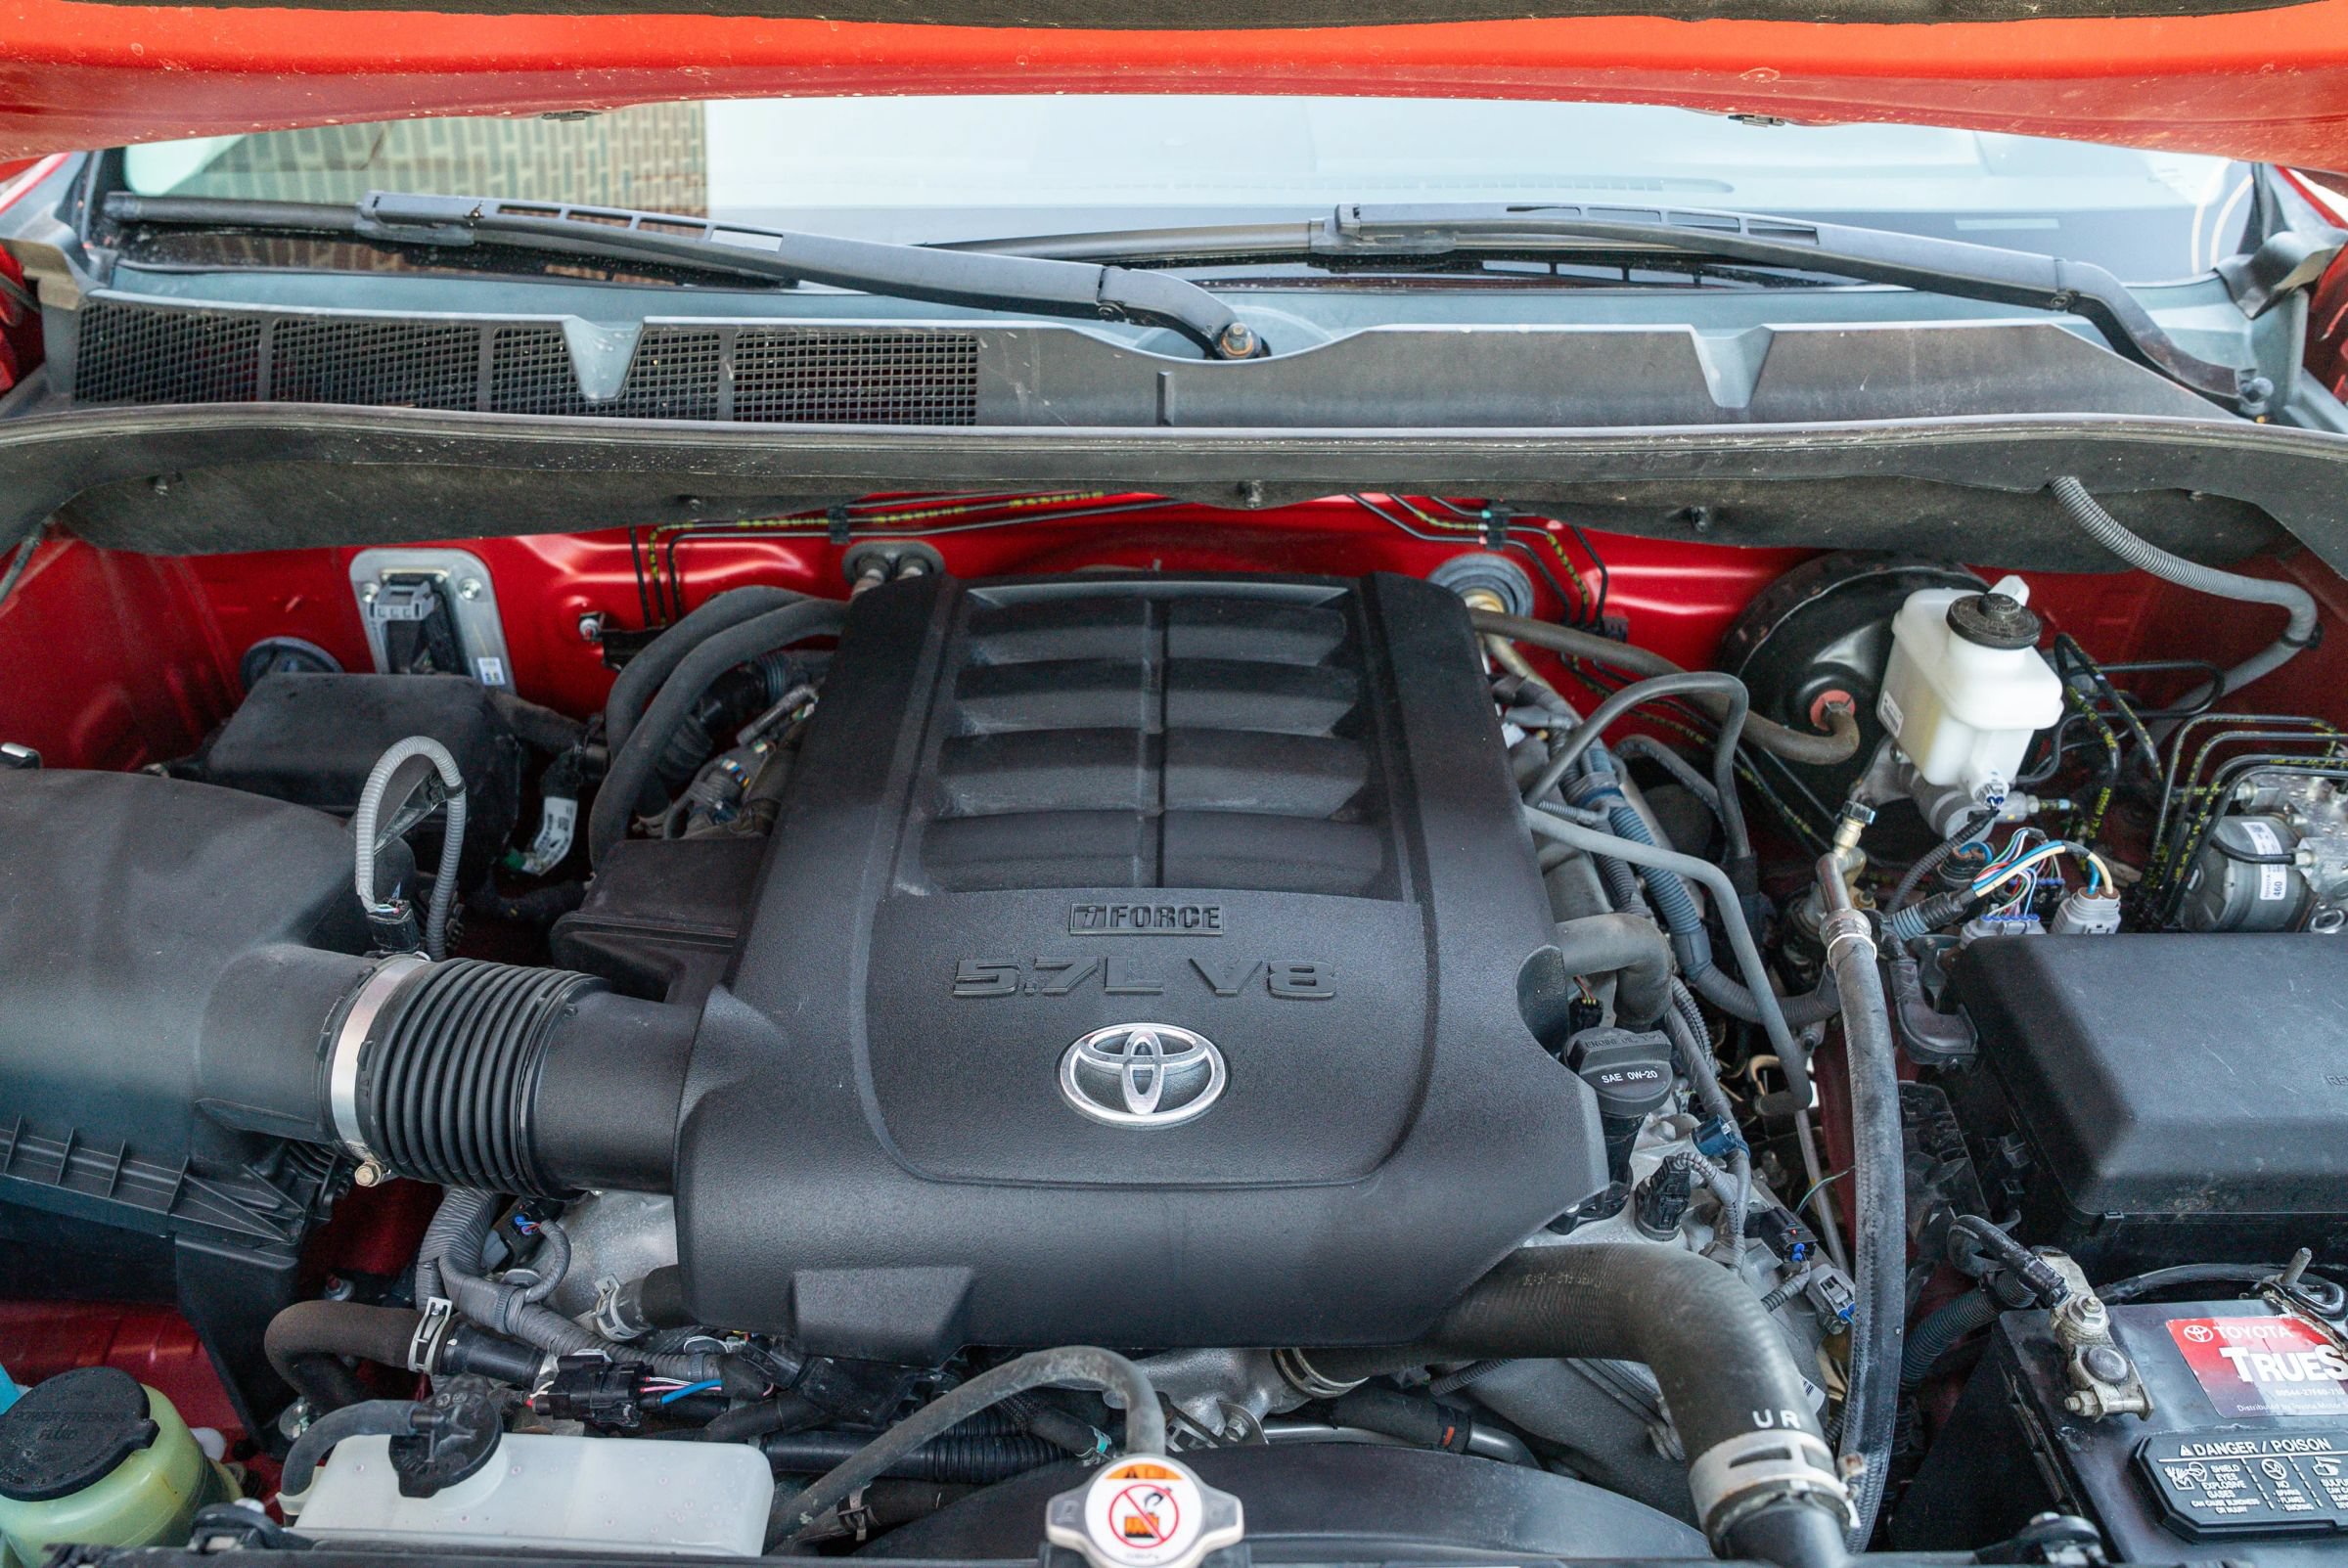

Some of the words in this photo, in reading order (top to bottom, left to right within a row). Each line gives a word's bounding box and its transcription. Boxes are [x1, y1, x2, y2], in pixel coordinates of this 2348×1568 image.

[953, 957, 1163, 996] 5.7L
[1189, 958, 1336, 1000] V8
[1602, 1073, 1623, 1084] SAE
[1627, 1070, 1658, 1080] 0W-20
[2213, 1325, 2294, 1339] TOYOTA
[2236, 1403, 2279, 1411] Distributed
[2192, 1441, 2259, 1456] DANGER
[2270, 1438, 2331, 1452] POISON
[2201, 1480, 2246, 1490] EXPLOSIVE
